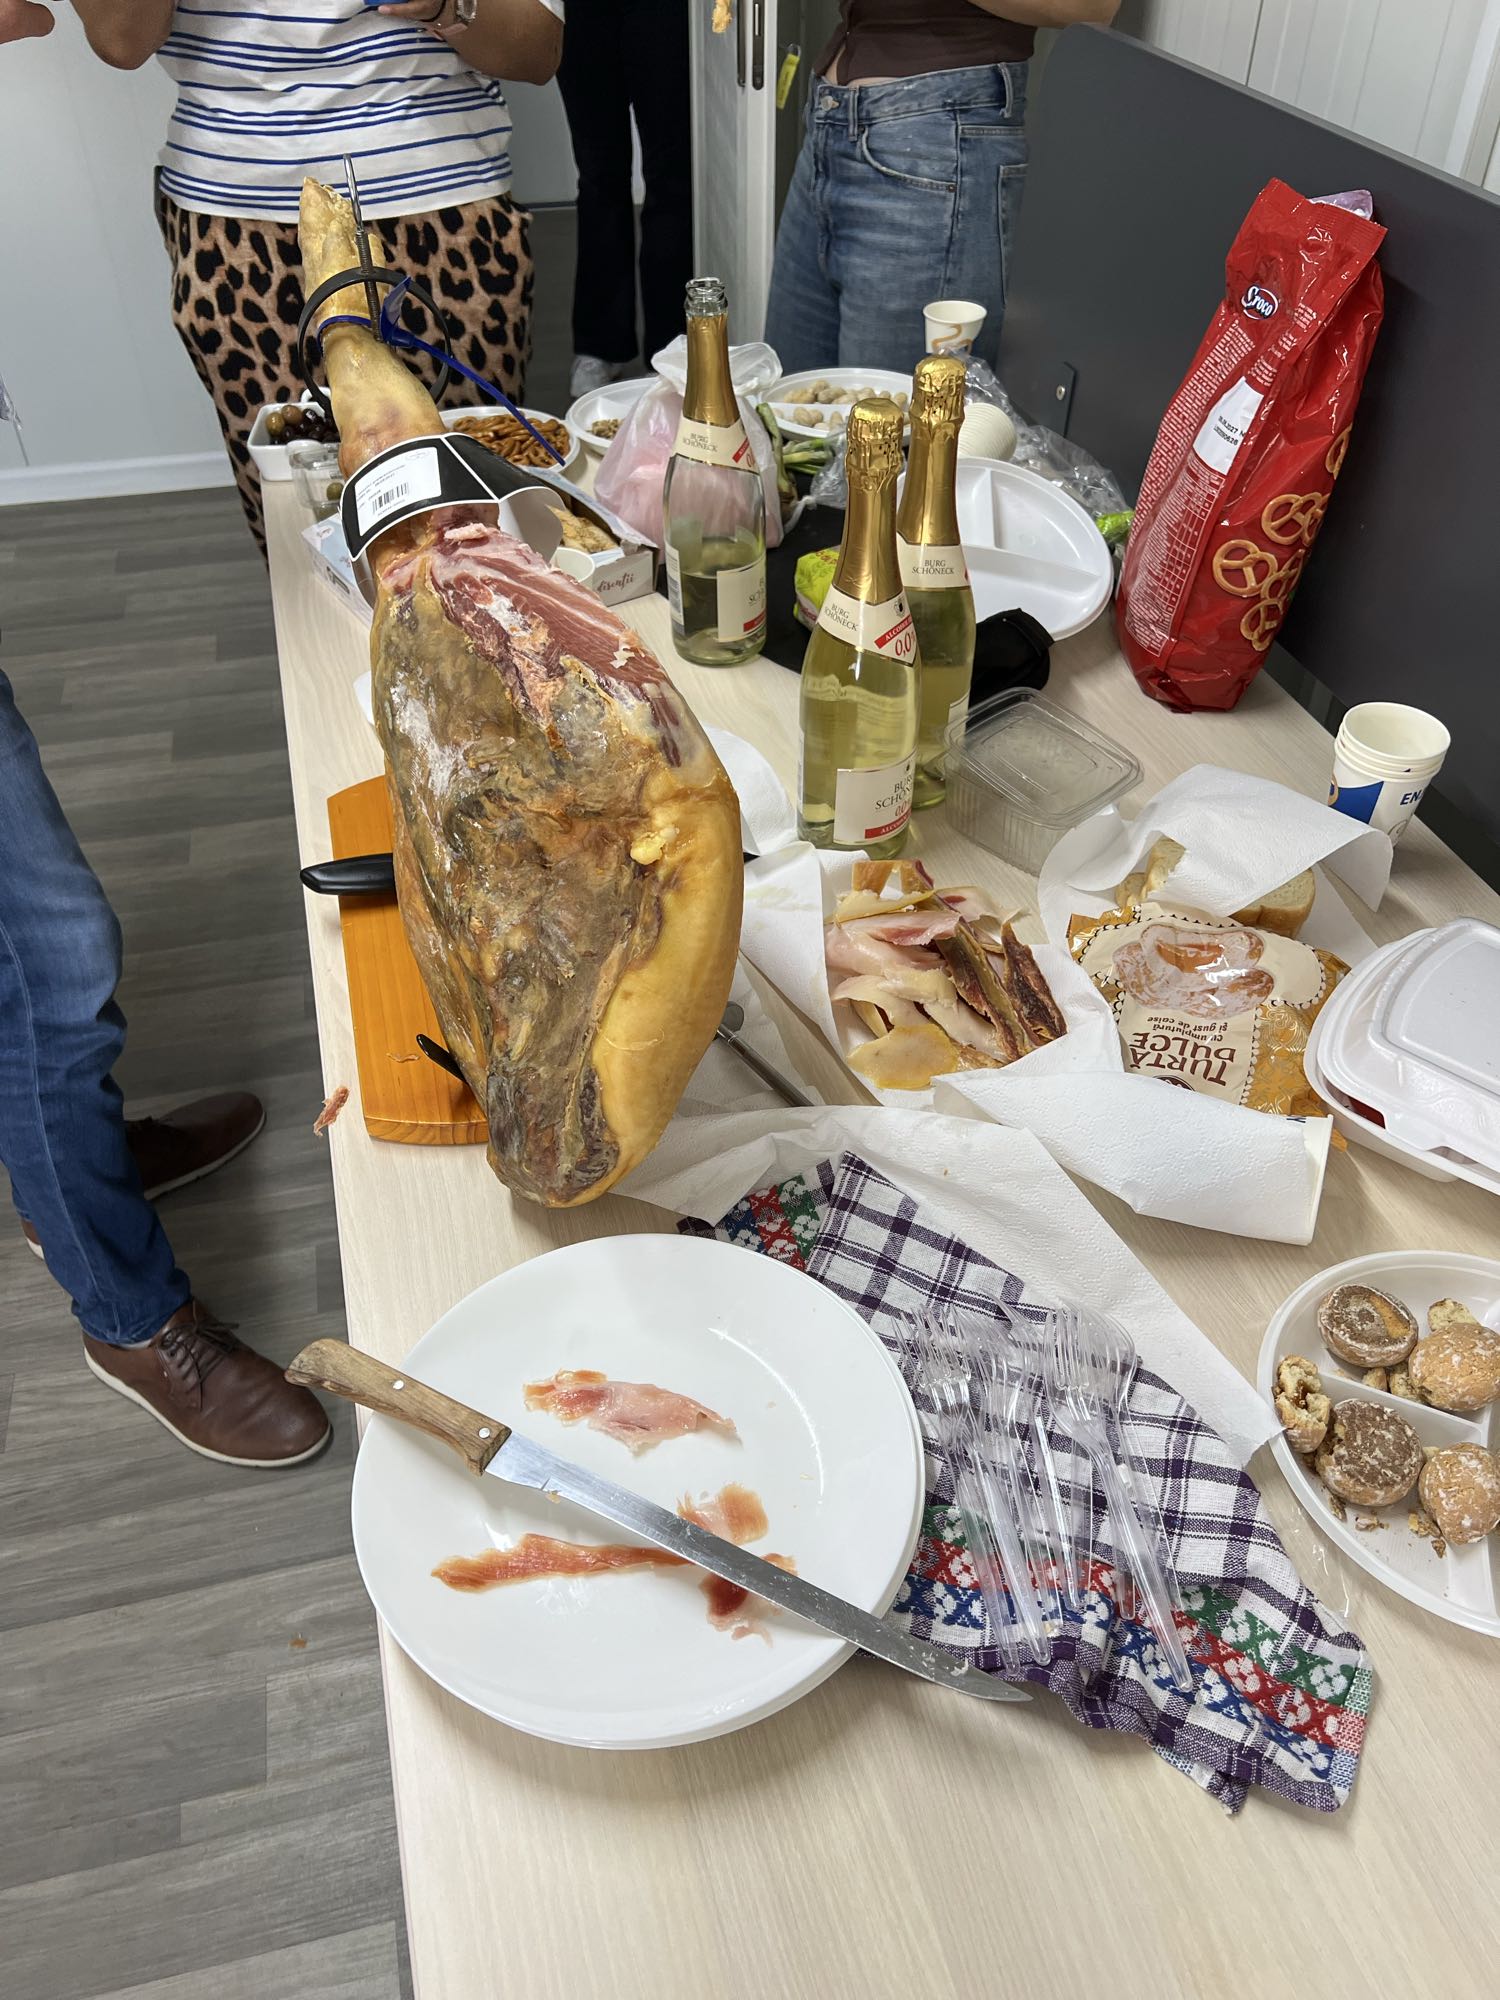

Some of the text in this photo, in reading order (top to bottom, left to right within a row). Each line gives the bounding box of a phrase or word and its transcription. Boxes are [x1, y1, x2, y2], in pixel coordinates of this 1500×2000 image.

[912, 566, 955, 575] SCHÖNECK
[924, 559, 946, 567] BURG
[824, 606, 859, 632] SCHÖNECK
[831, 603, 850, 619] BURG
[1400, 789, 1424, 806] EN
[1147, 1016, 1175, 1024] caise
[1178, 1020, 1190, 1029] de
[1193, 1022, 1217, 1032] gust
[1152, 1023, 1207, 1042] umplutură
[1129, 1032, 1236, 1063] DULCE
[1130, 1048, 1227, 1086] TURTĂ
